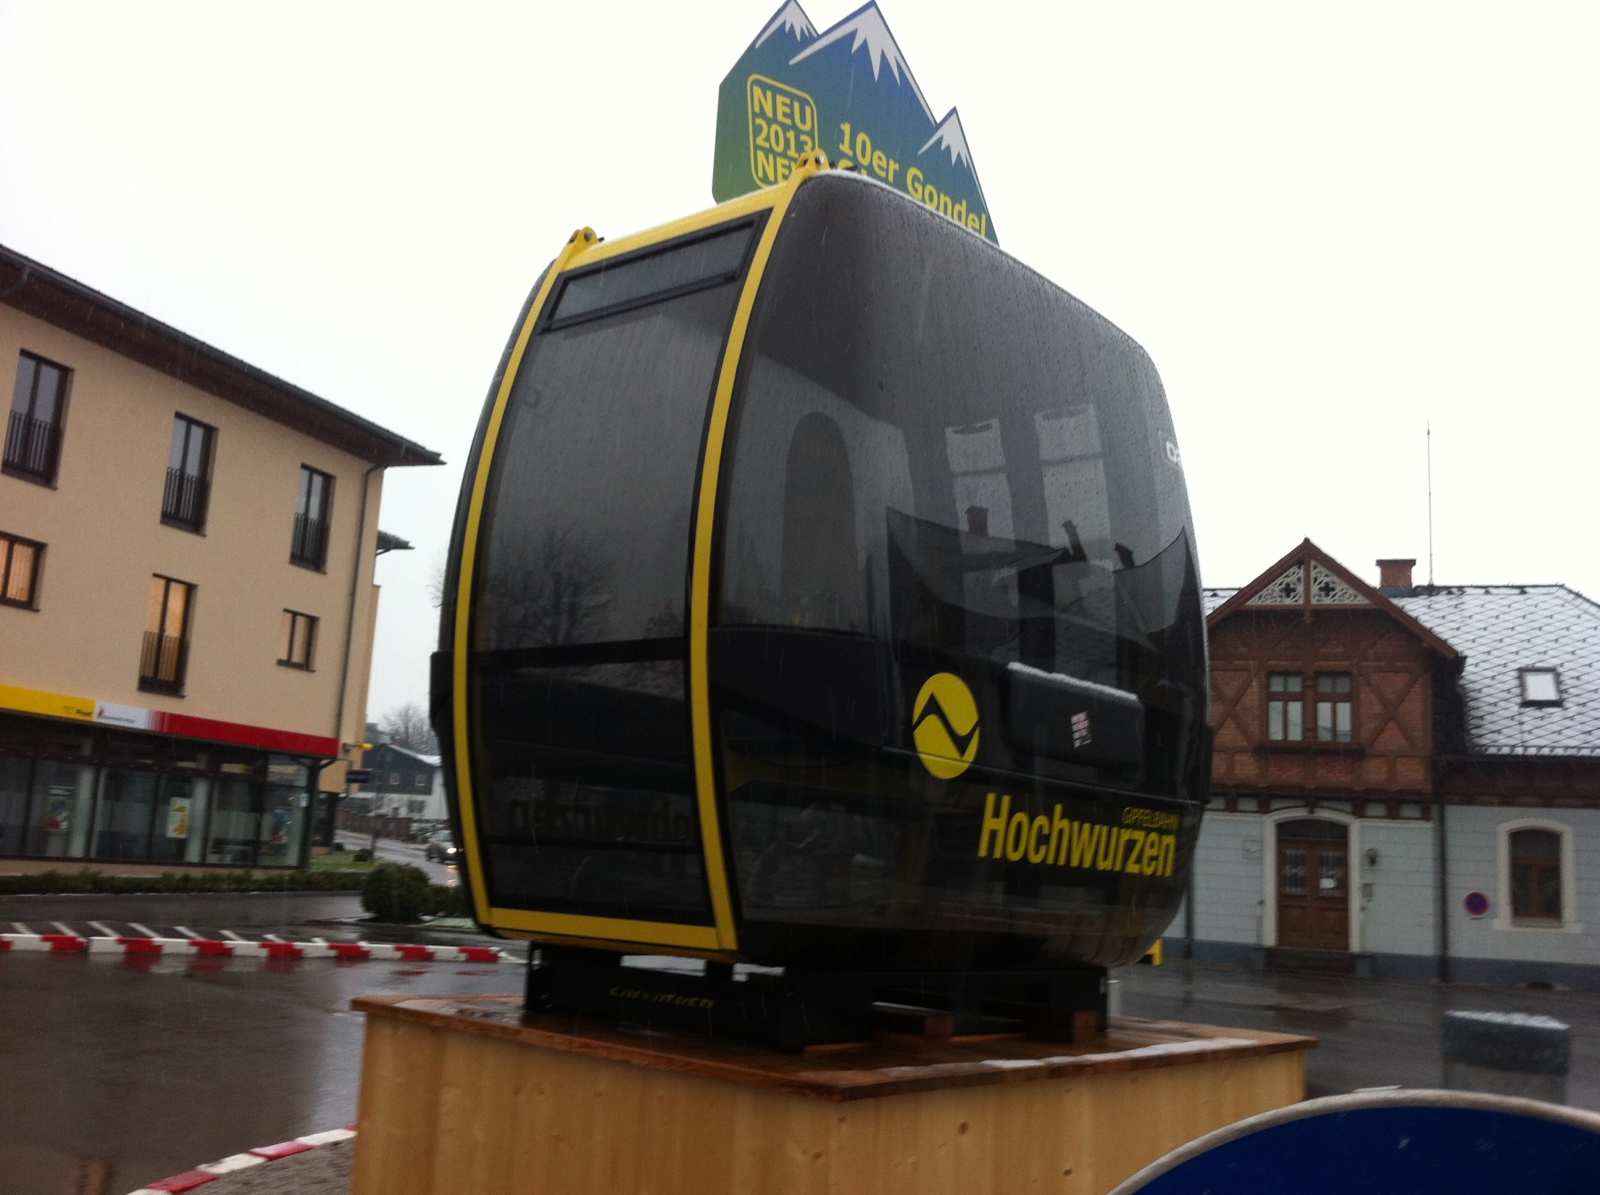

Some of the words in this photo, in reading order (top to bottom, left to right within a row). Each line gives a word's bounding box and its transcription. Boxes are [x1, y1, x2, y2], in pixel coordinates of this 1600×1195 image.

[752, 84, 812, 132] NEU
[755, 118, 812, 155] 2013
[839, 122, 900, 184] 10er
[907, 167, 987, 238] Gondel
[977, 792, 1177, 878] Hochwurzen
